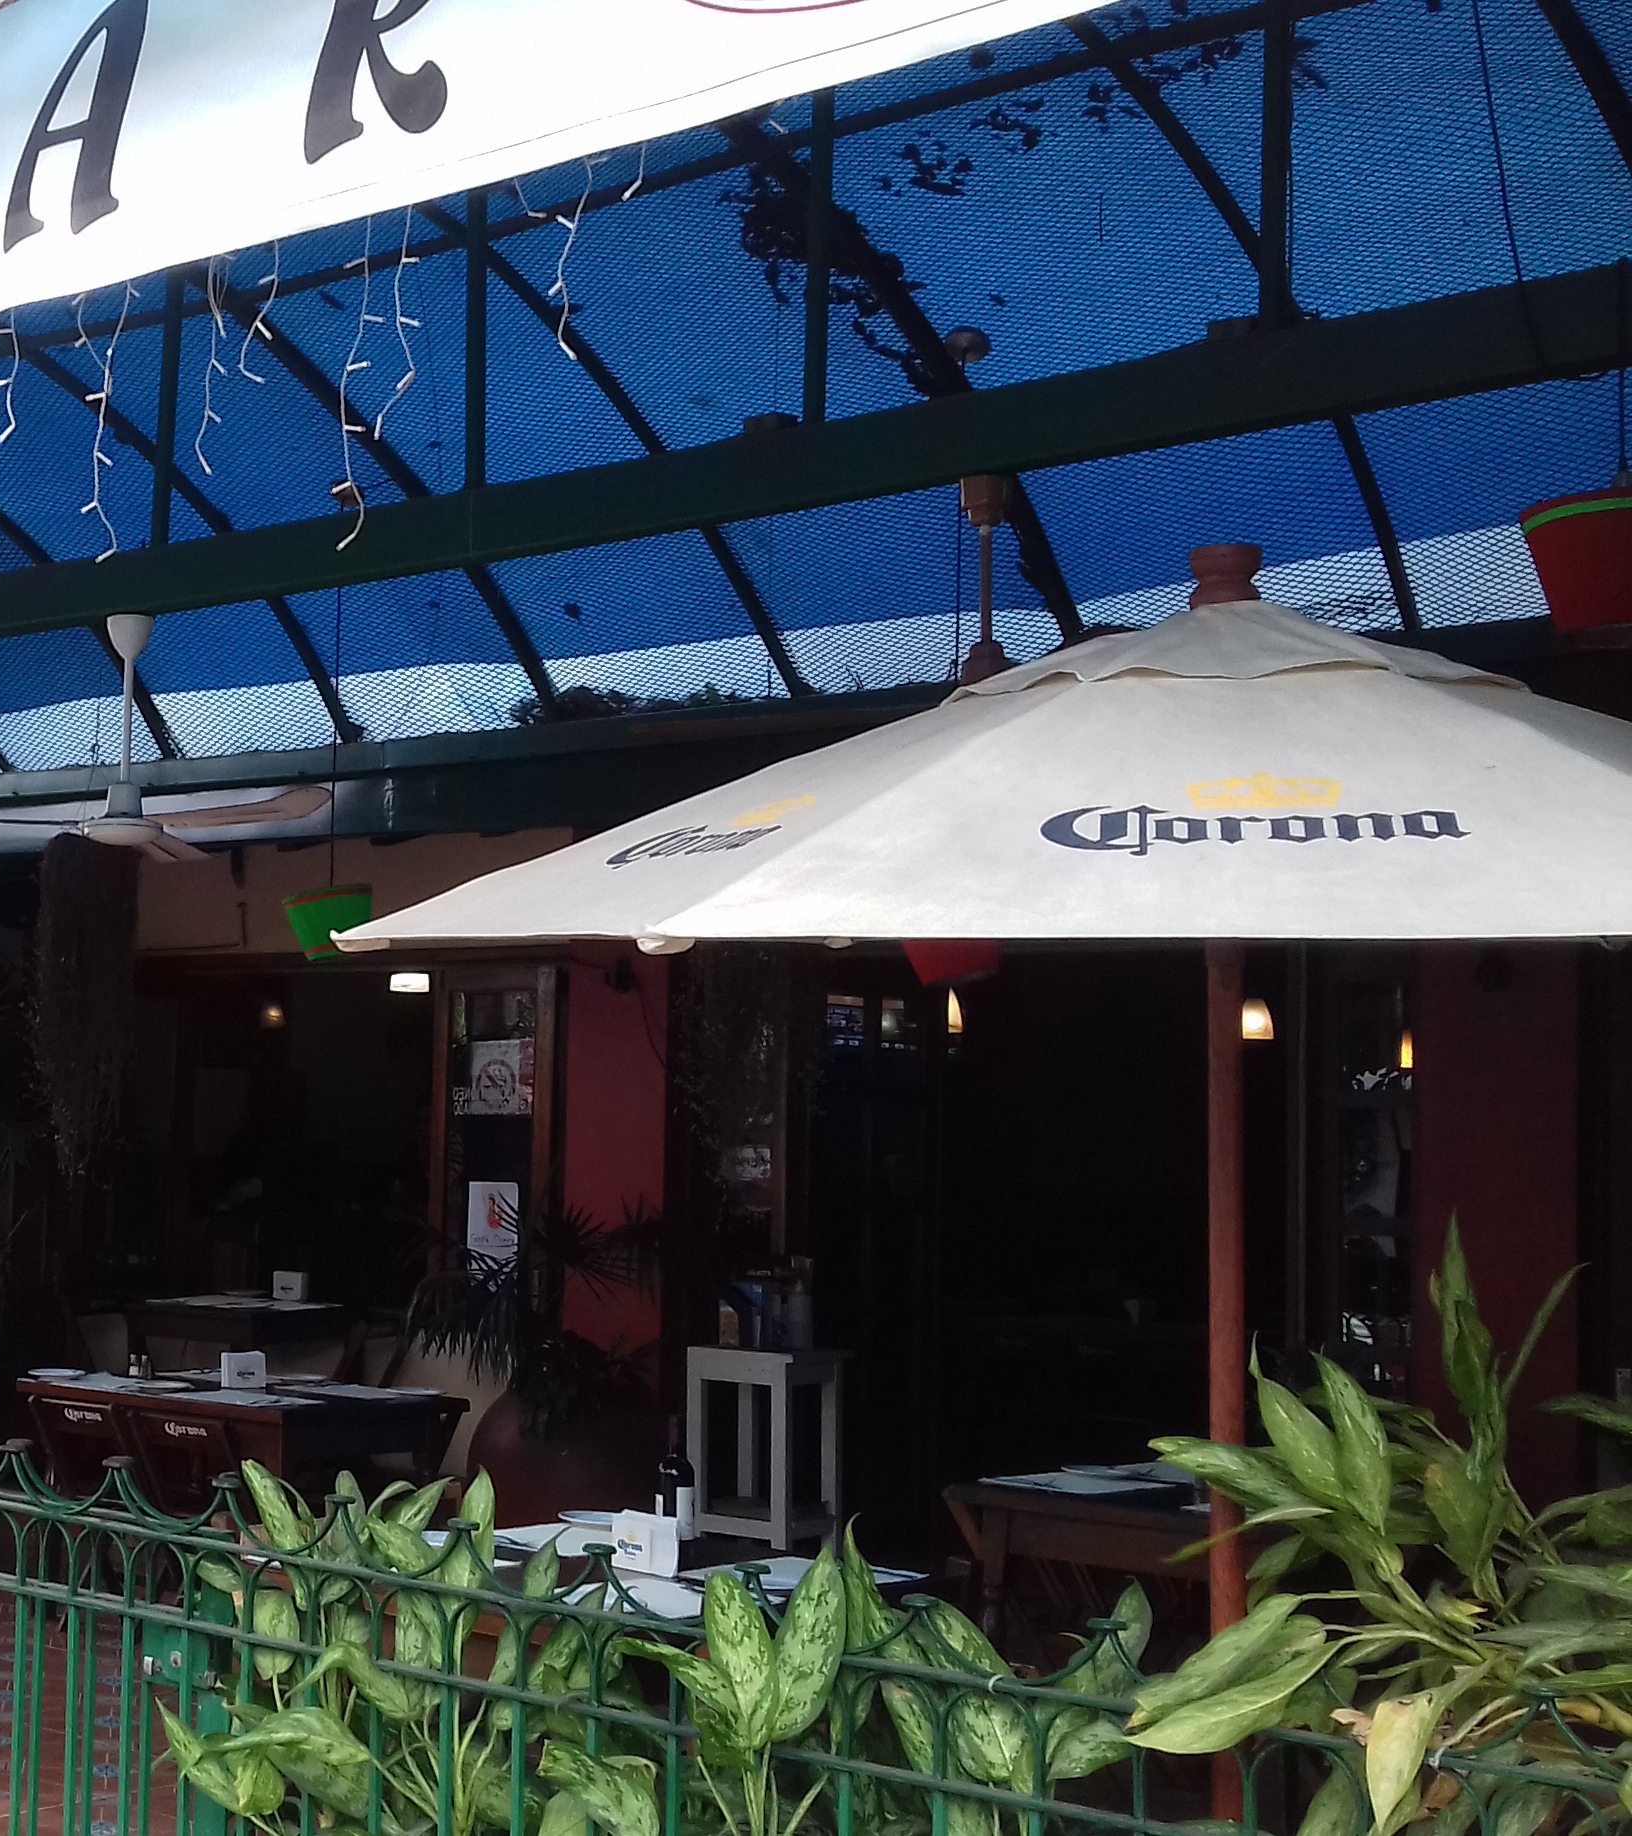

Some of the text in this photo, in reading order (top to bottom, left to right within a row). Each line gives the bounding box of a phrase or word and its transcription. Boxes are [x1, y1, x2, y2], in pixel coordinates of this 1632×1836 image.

[1040, 804, 1472, 857] Corona
[606, 825, 783, 870] Corona
[64, 1407, 103, 1422] Corona
[164, 1421, 208, 1437] Corona
